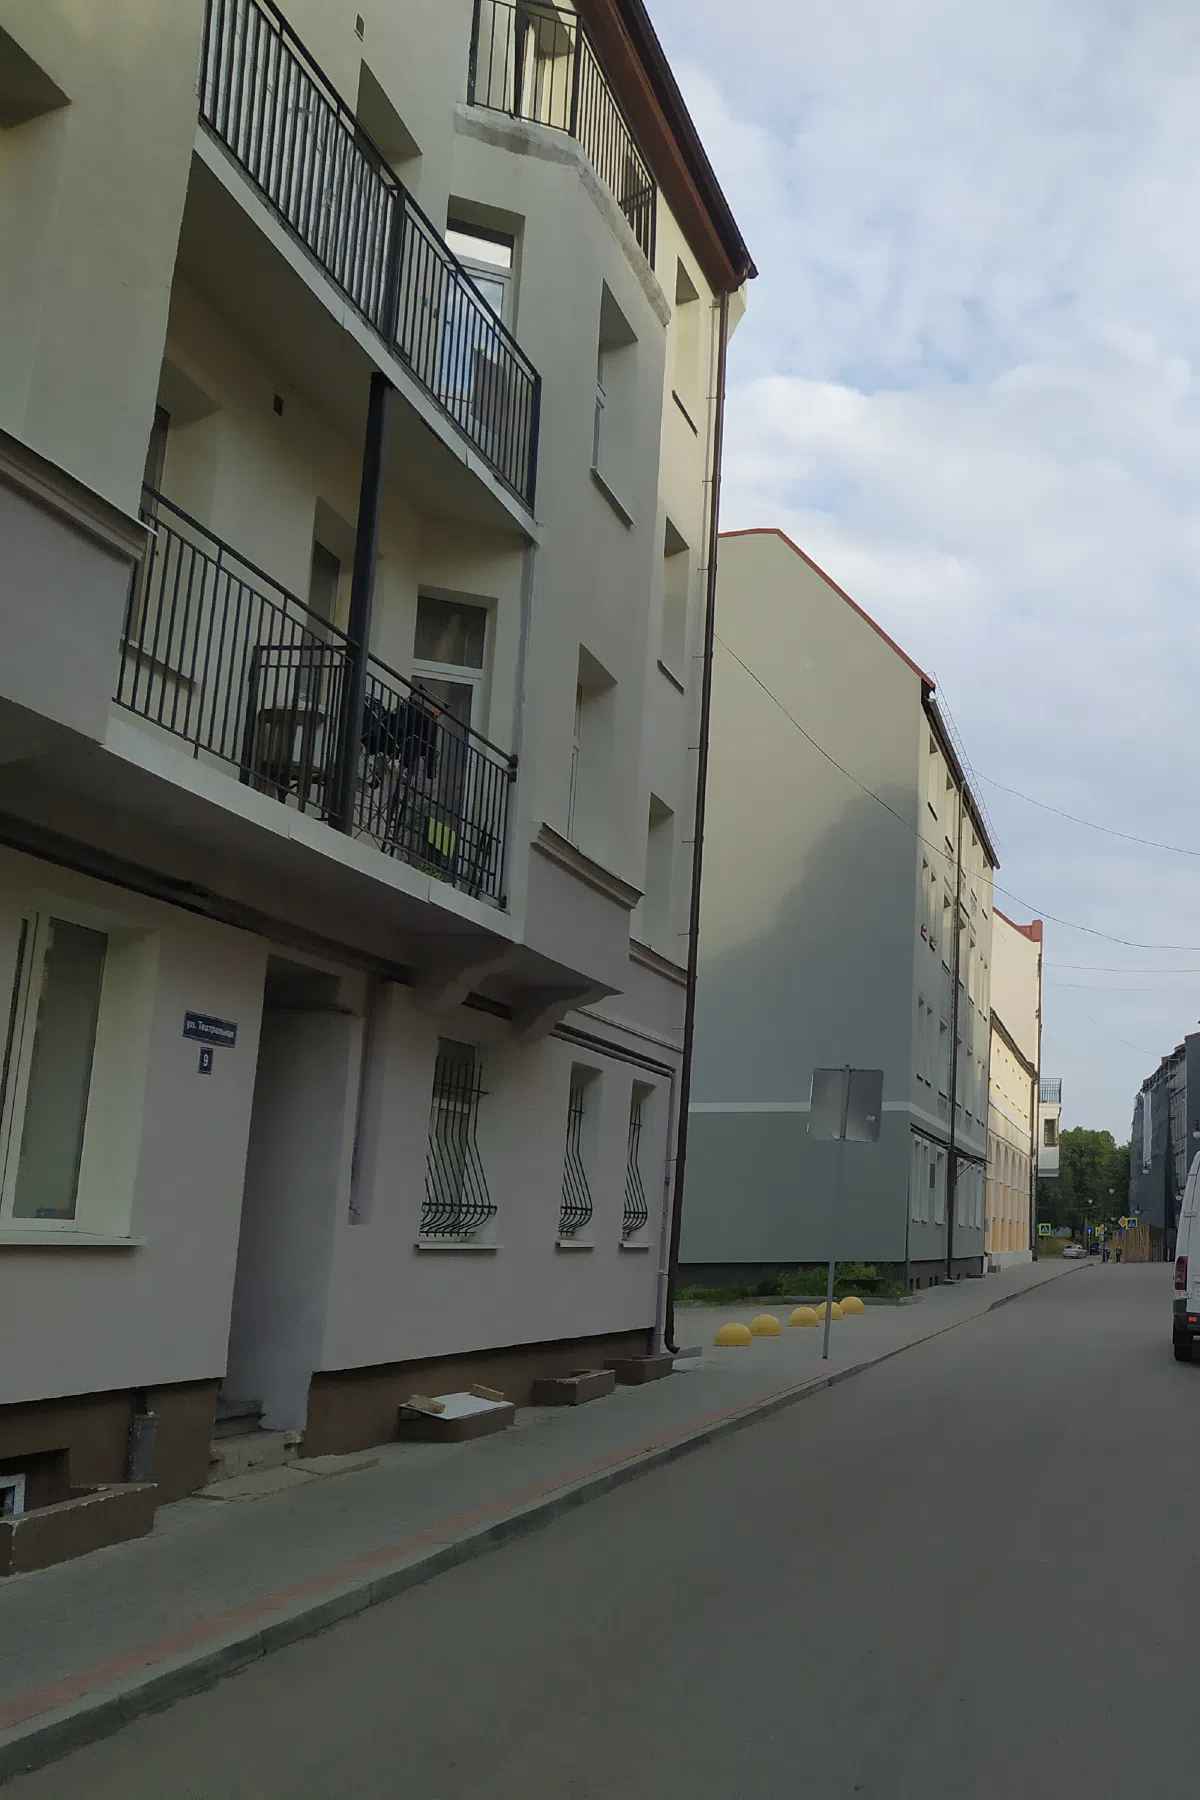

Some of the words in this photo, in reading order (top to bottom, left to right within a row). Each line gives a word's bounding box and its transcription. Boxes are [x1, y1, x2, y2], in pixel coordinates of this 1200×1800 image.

[186, 1020, 196, 1029] ул.
[198, 1020, 234, 1038] Театральная
[203, 1054, 209, 1067] 9
